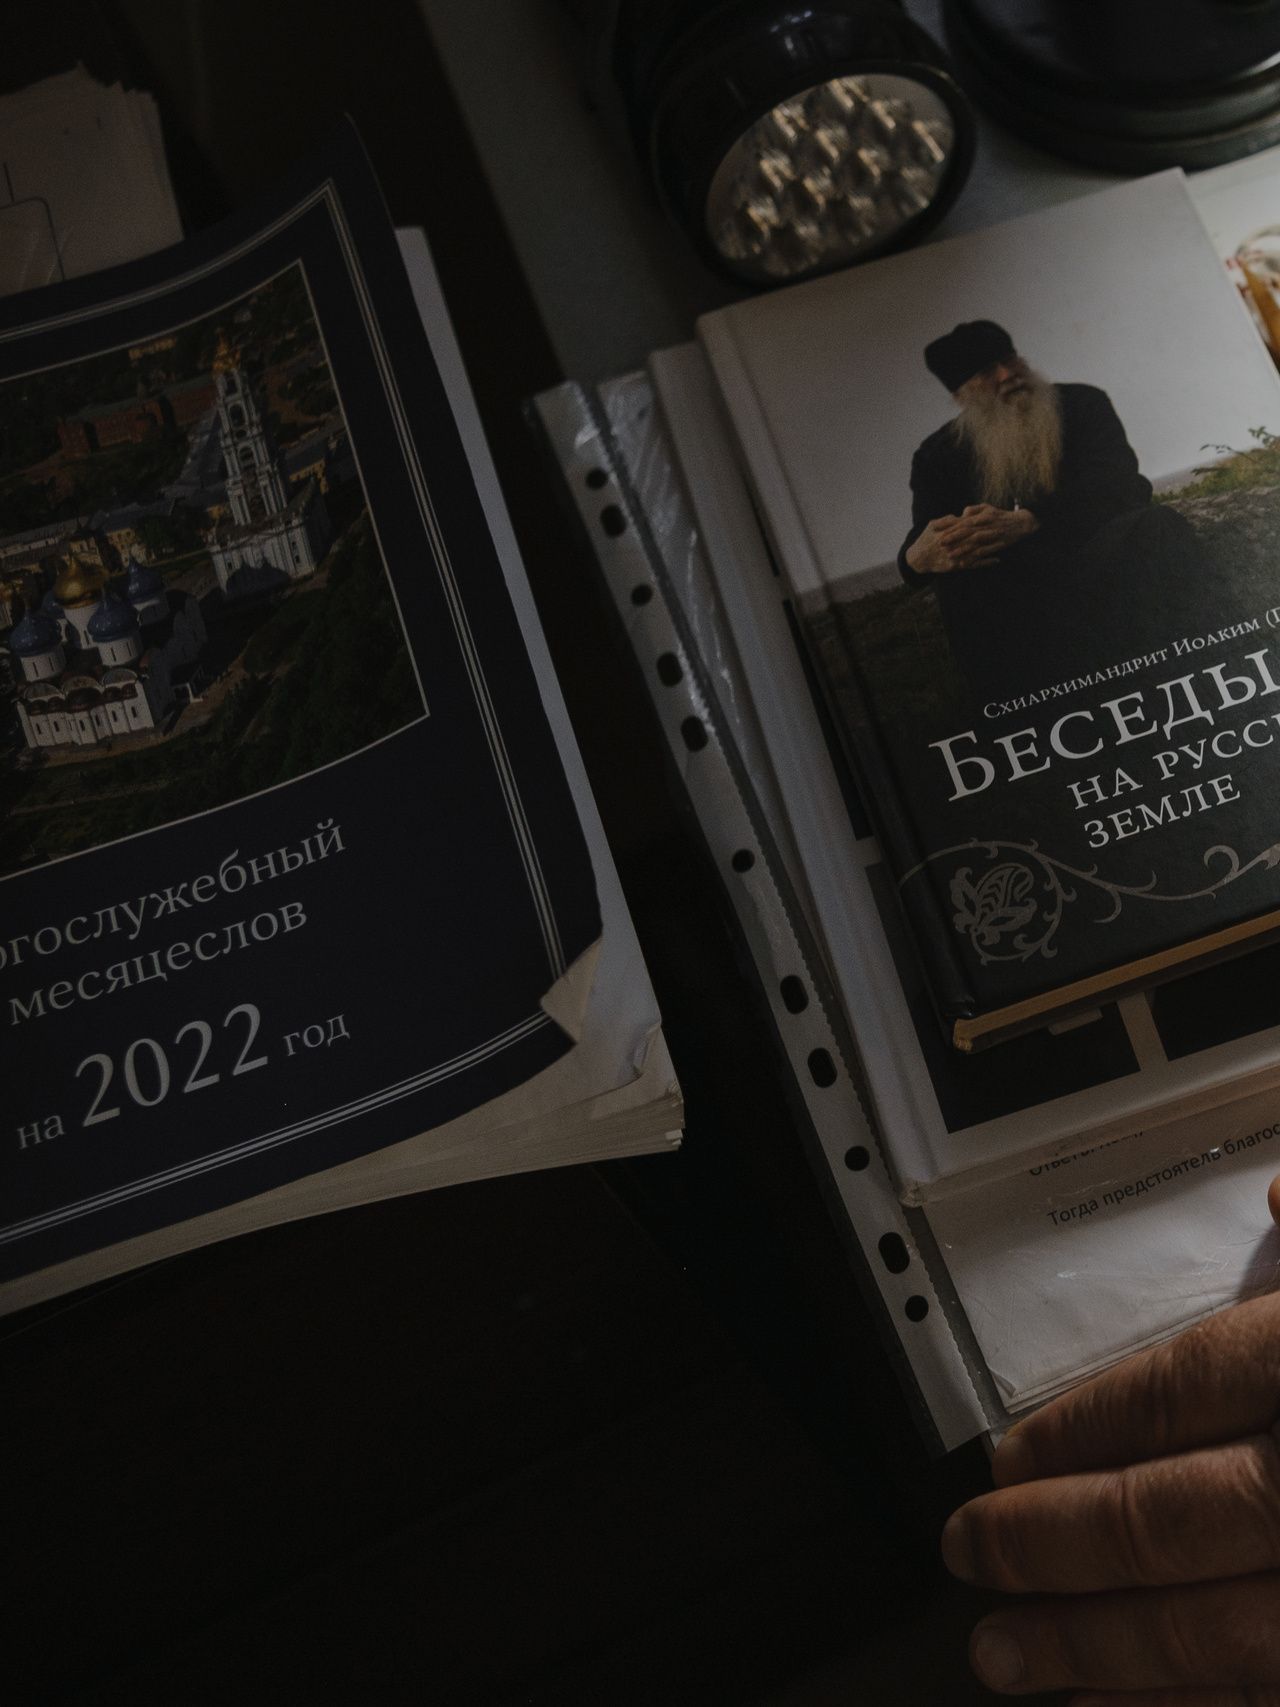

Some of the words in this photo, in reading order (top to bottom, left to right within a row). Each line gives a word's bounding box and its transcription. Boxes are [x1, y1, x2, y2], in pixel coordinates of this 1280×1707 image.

[1067, 767, 1143, 810] НА
[1084, 773, 1241, 849] ЗЕМЛЕ
[0, 818, 346, 970] гослужебный
[9, 901, 308, 1026] месяцеслов
[16, 1113, 66, 1149] на
[75, 1003, 268, 1127] 2022
[283, 1014, 351, 1056] год
[1047, 1199, 1099, 1228] Тогда
[1102, 1147, 1222, 1209] предстоятель
